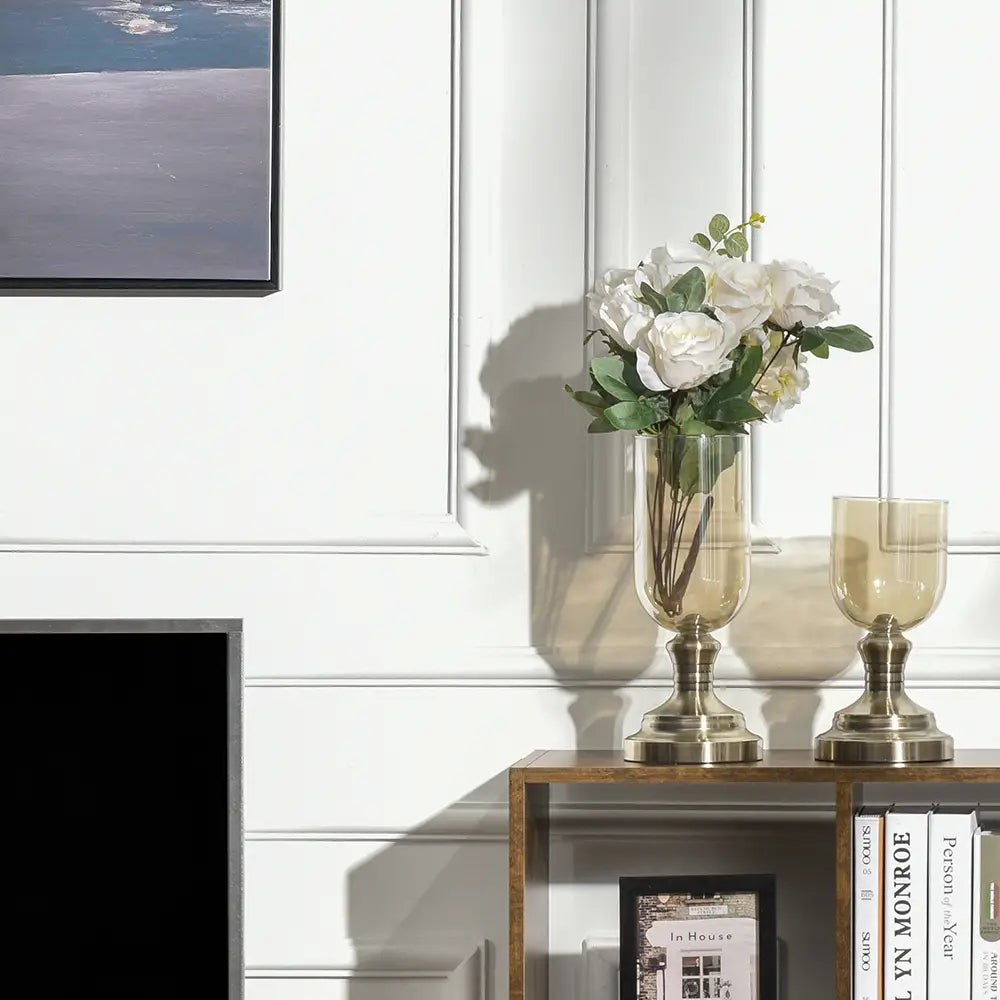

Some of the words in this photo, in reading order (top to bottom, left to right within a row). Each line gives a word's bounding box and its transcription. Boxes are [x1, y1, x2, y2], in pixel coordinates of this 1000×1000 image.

[893, 832, 912, 937] MONROE
[943, 837, 957, 896] Person
[942, 896, 951, 906] of
[670, 932, 683, 942] In
[688, 932, 733, 942] House
[943, 922, 958, 961] Year
[895, 946, 913, 980] YN
[989, 952, 999, 993] AROUND
